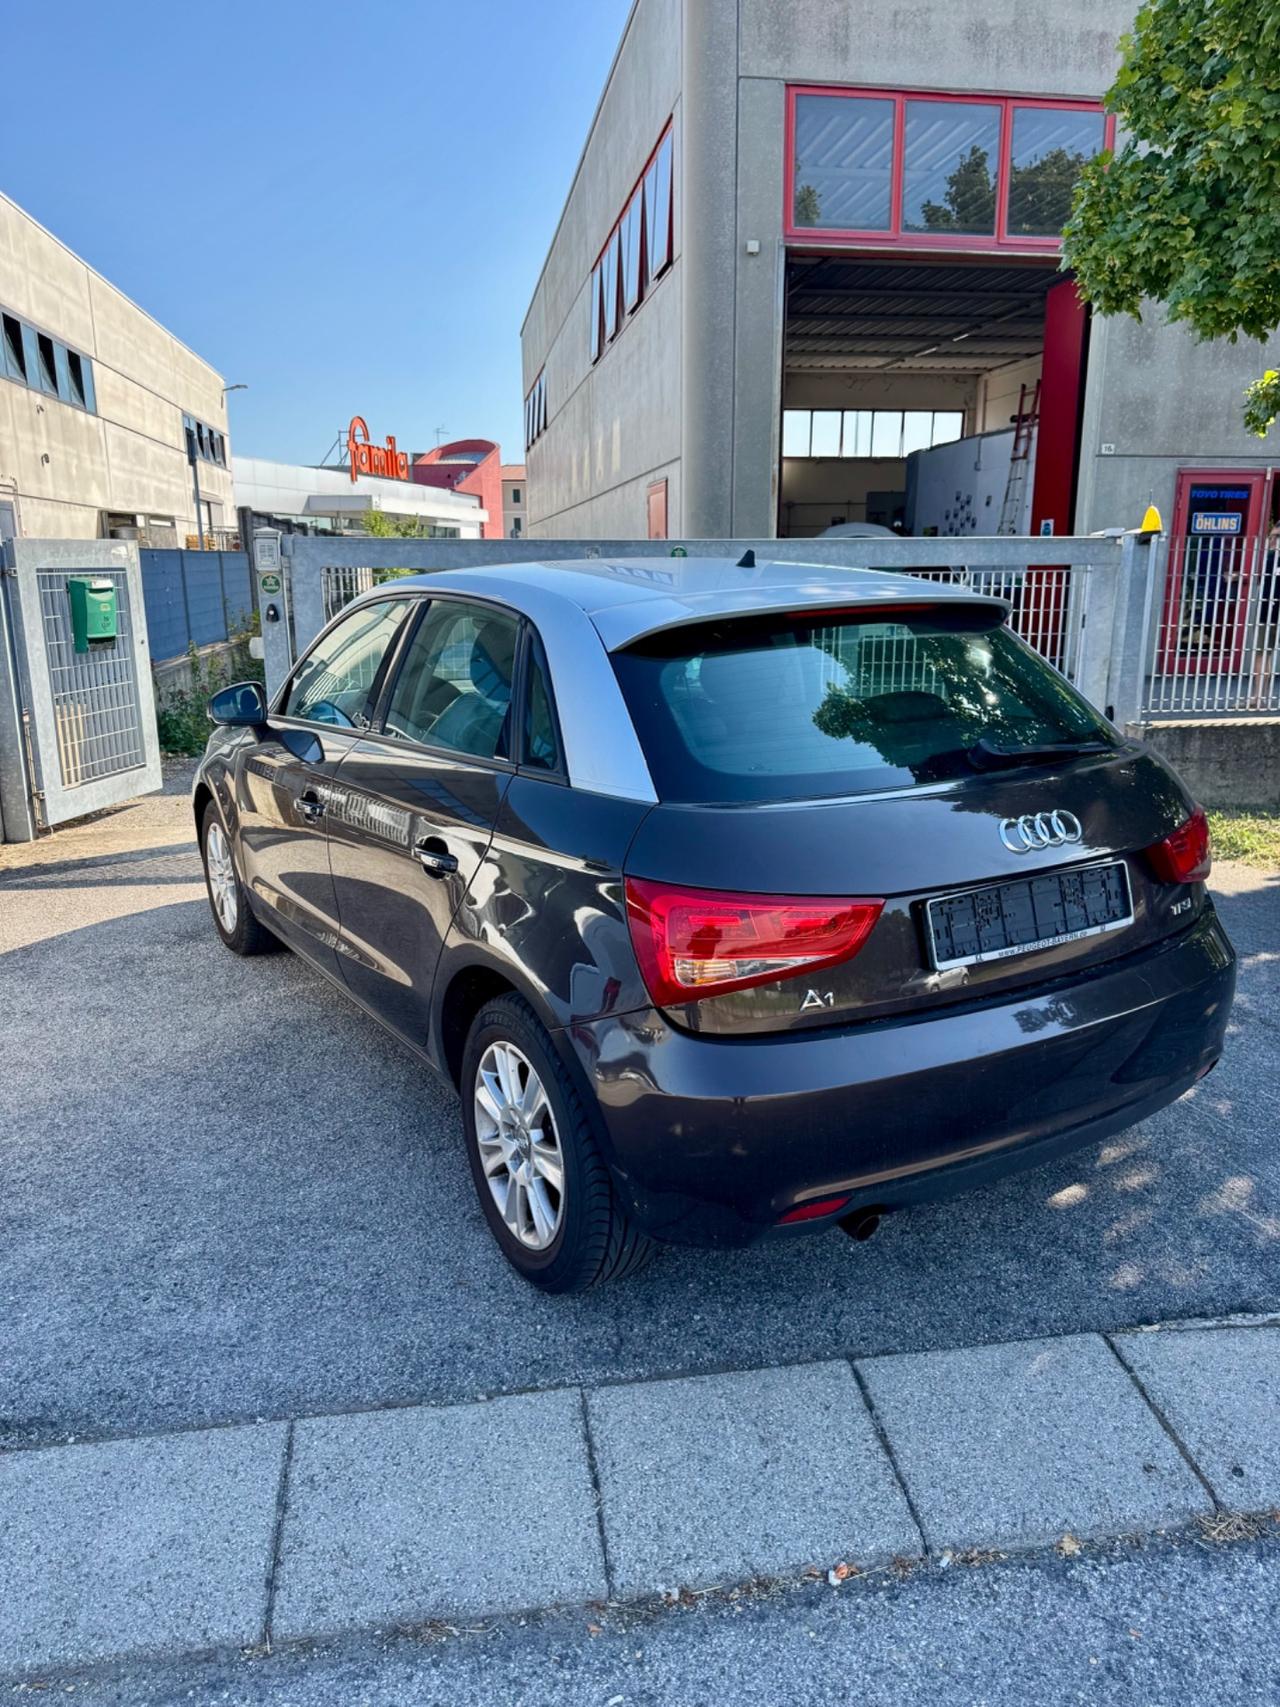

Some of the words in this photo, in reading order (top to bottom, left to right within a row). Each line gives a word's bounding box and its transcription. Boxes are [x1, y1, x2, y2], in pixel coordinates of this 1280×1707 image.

[347, 415, 409, 484] famila
[1191, 490, 1218, 499] TOYO
[1219, 490, 1249, 499] TIRES
[1196, 514, 1238, 530] ÖHLINS
[800, 989, 834, 1012] A1
